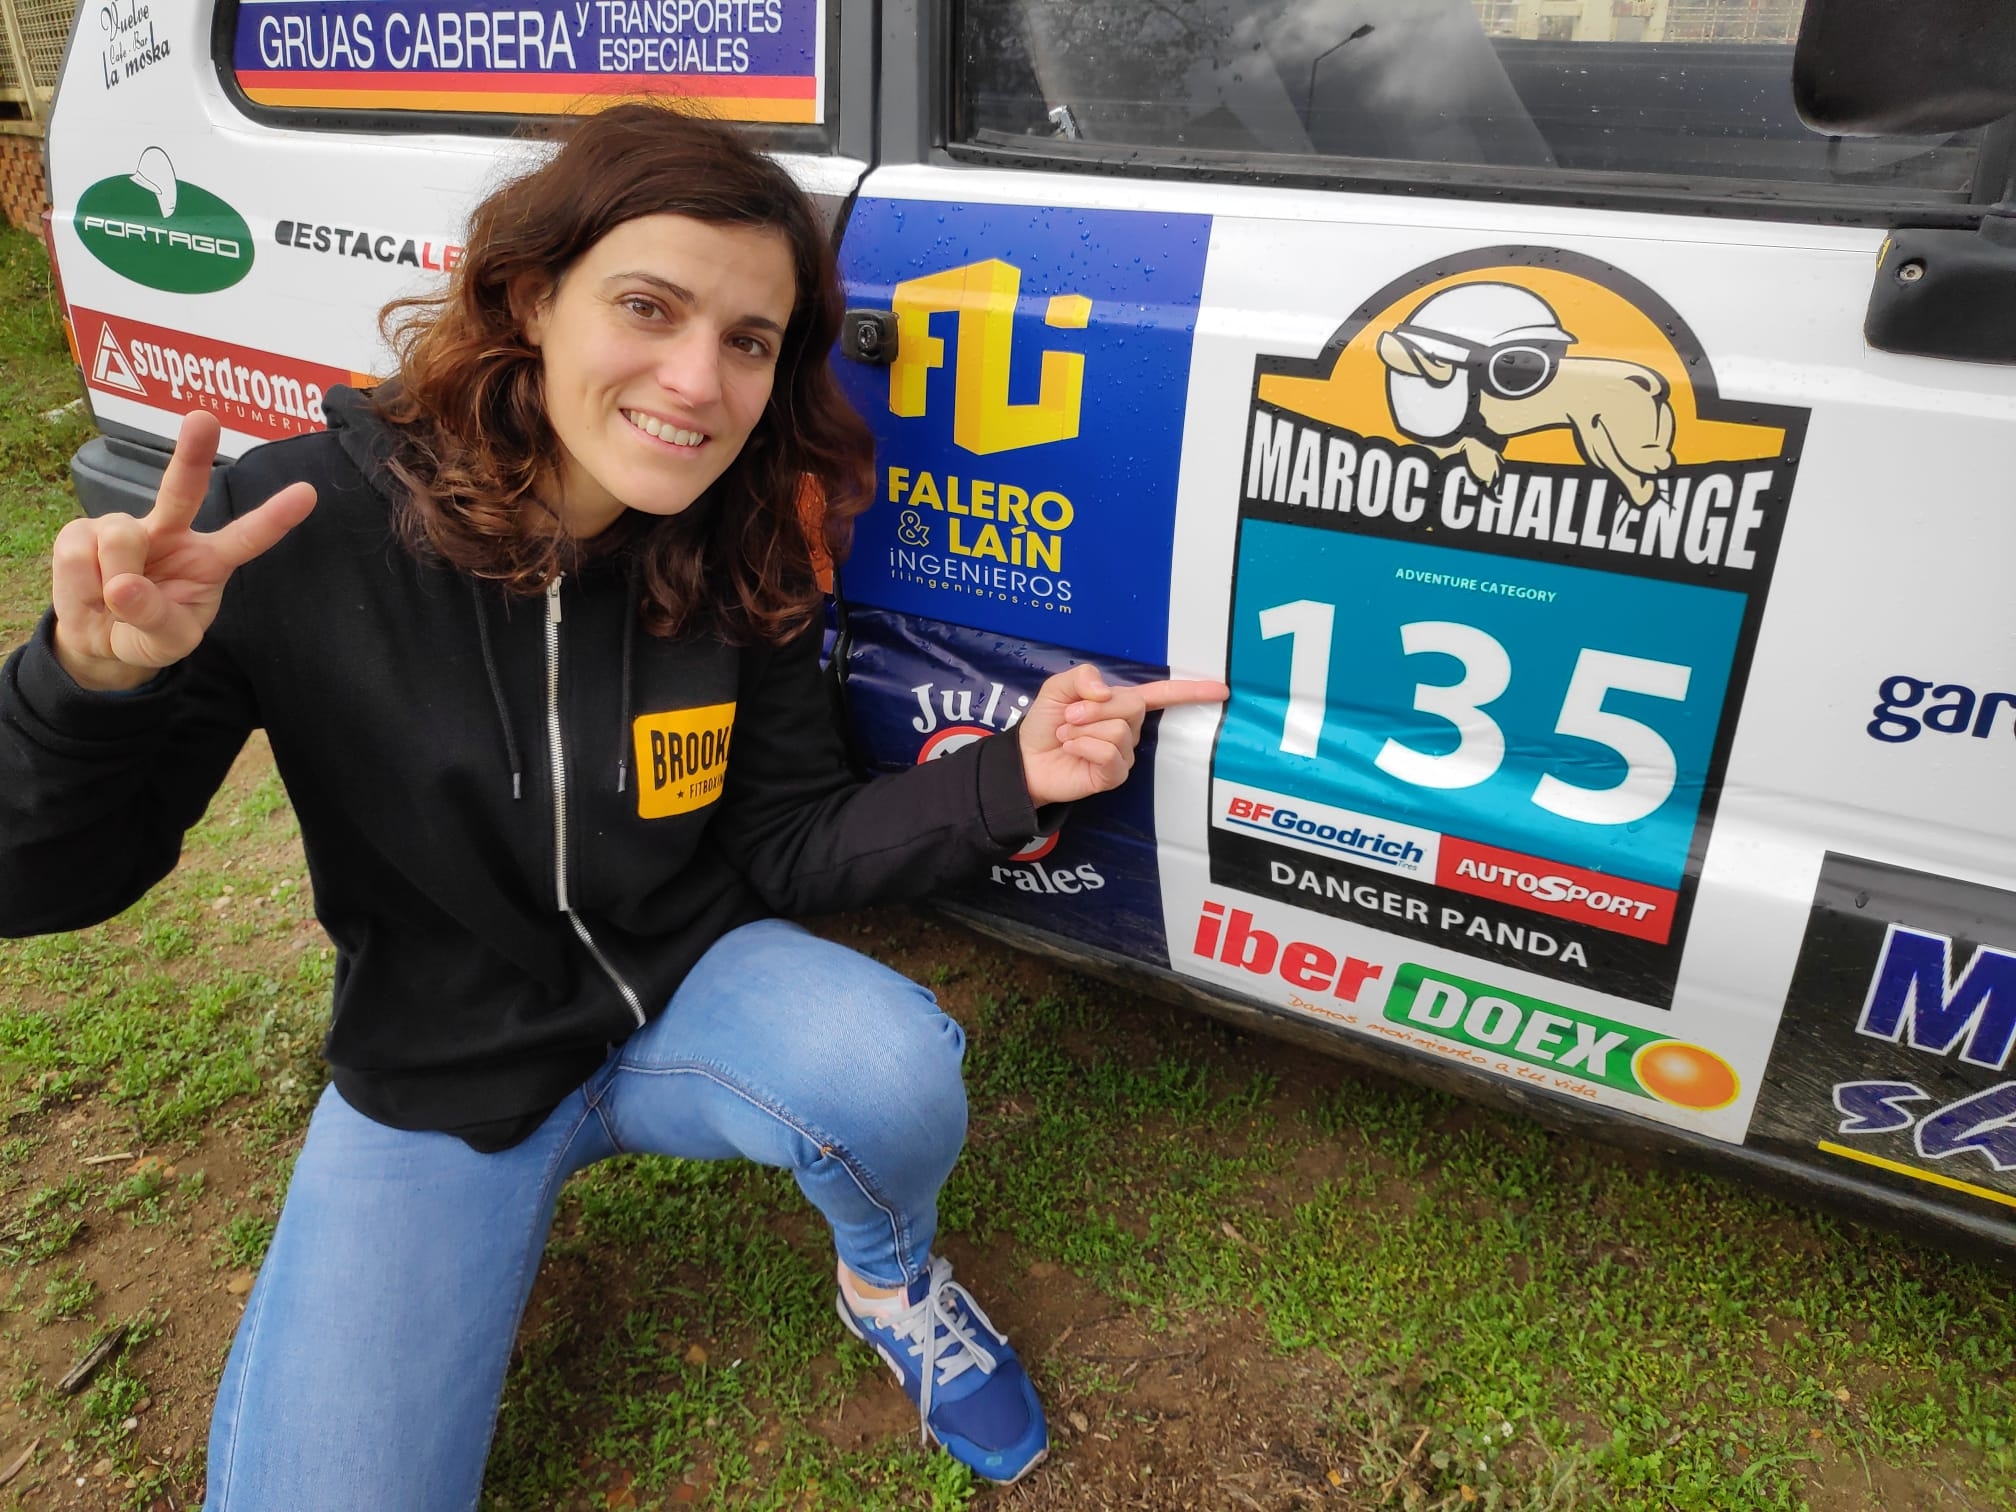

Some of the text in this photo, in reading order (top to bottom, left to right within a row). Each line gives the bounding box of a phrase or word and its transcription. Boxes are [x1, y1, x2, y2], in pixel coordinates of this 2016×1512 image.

[100, 0, 149, 41] Vuelve
[258, 10, 577, 70] GRUAS CABRERA
[575, 0, 783, 37] y TRANSPORTES
[103, 20, 171, 90] la moska
[600, 37, 749, 73] ESPECIALES
[84, 216, 240, 259] PORTAGO
[130, 338, 328, 426] superdroma
[889, 466, 1075, 531] FALERO
[1246, 409, 1774, 570] MAROC CHALLENGE
[897, 510, 930, 548] &
[891, 569, 1072, 614] flingenieros.com
[1395, 568, 1557, 603] ADVENTURE CATEGORY
[1258, 599, 1693, 826] 135
[1866, 675, 2016, 743] gar
[1227, 797, 1424, 864] BFGoodrich
[1270, 861, 1589, 969] DANGER PANDA
[1193, 902, 1630, 1078] iber DOEX
[1553, 1078, 1599, 1100] vida
